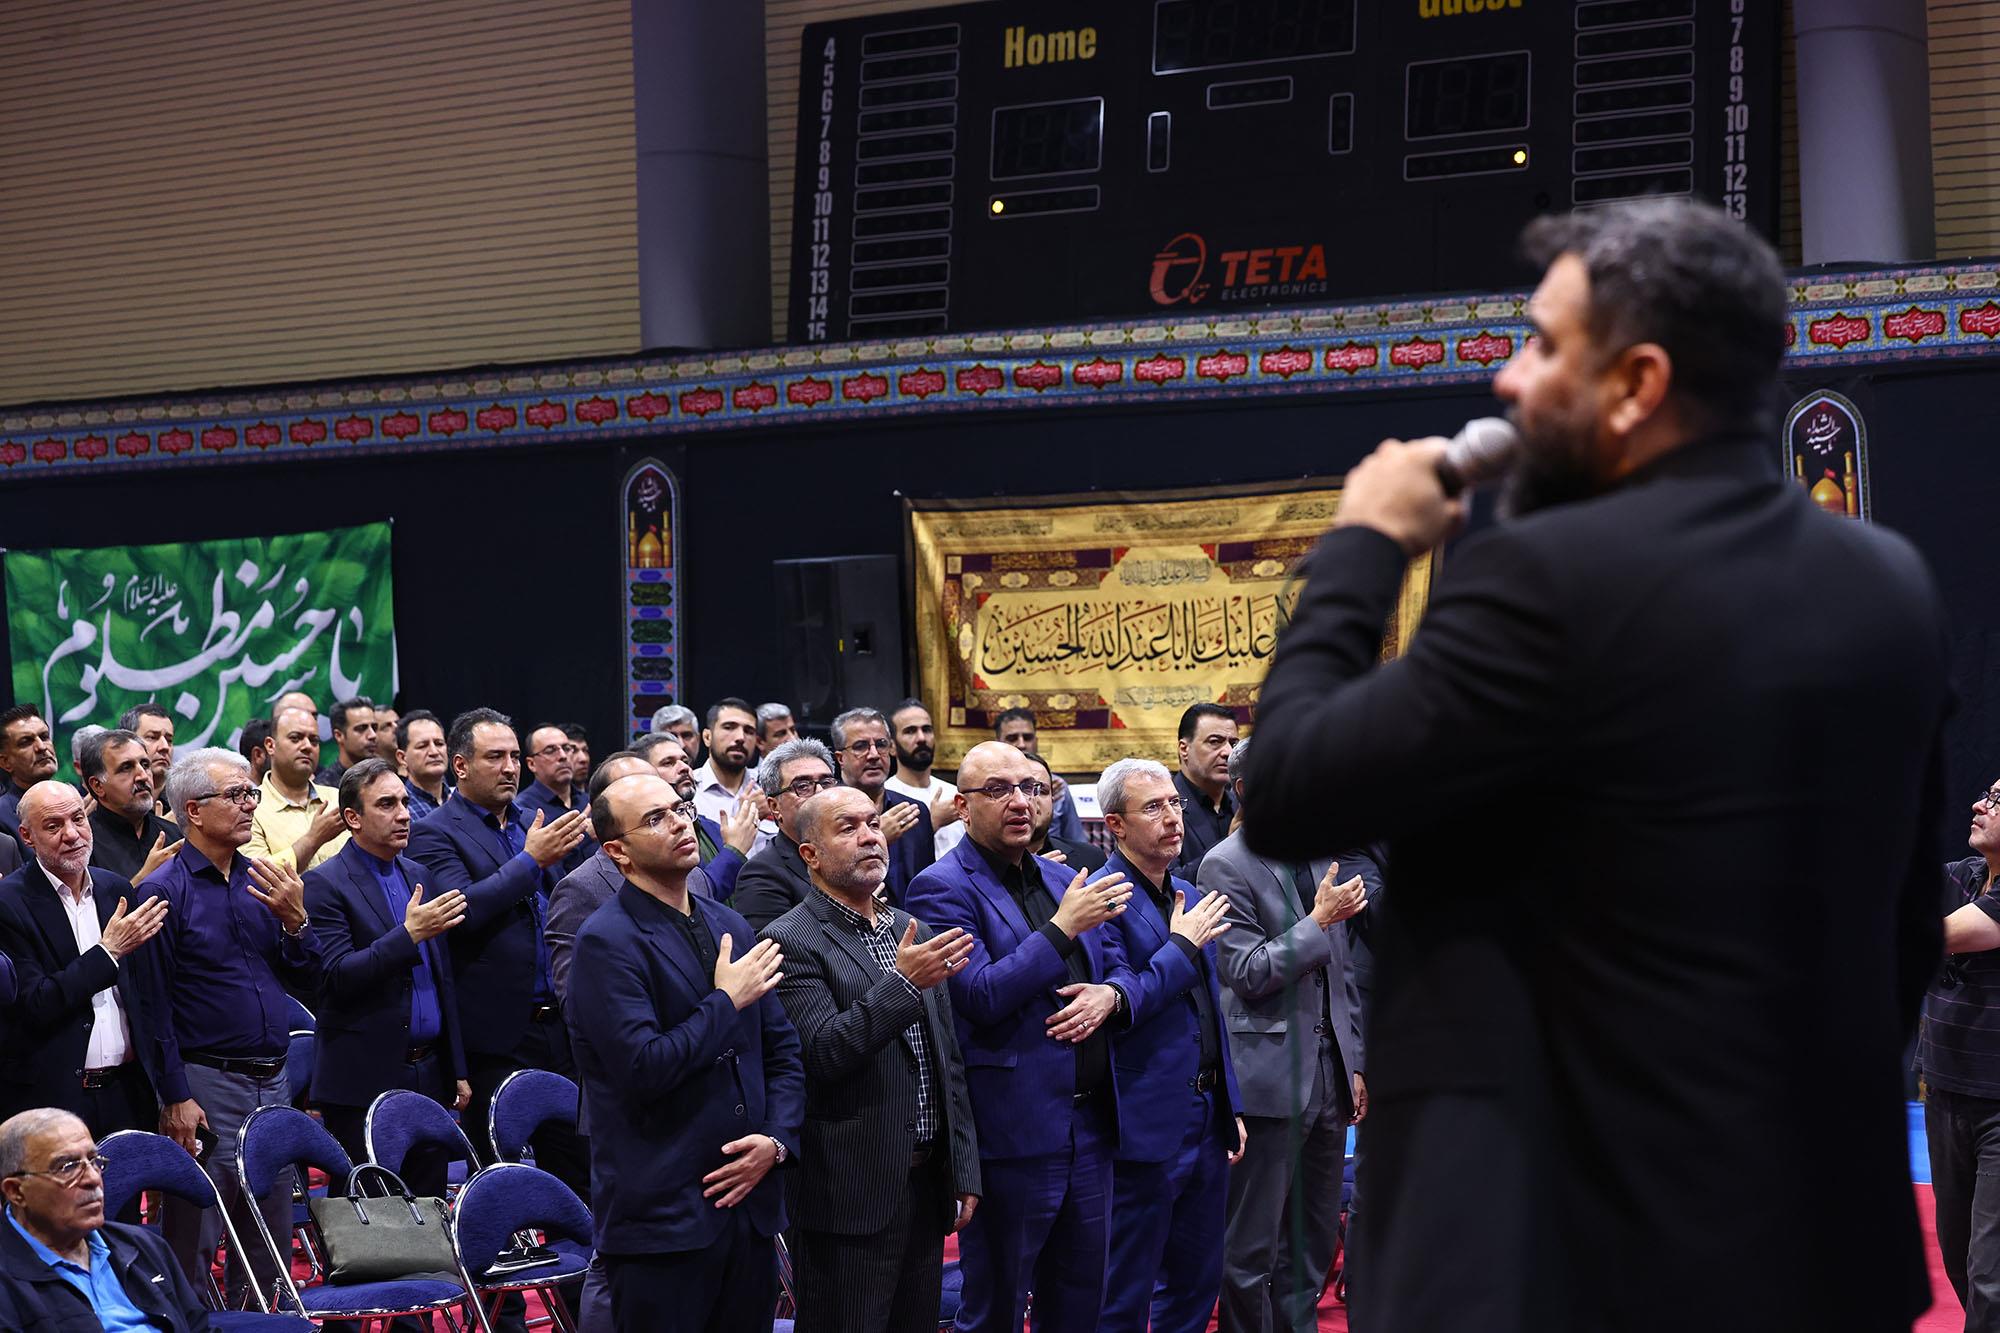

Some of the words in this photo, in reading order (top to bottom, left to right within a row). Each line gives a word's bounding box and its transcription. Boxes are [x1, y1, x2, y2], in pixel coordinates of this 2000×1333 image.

[1731, 16, 1744, 43] 7
[823, 37, 836, 61] 4
[1005, 27, 1096, 68] Home
[1730, 46, 1744, 73] 8
[823, 63, 834, 87] 5
[821, 88, 833, 112] 6
[1729, 75, 1743, 102] 9
[821, 114, 831, 139] 7
[1724, 104, 1749, 132] 10
[819, 140, 831, 164] 8
[1724, 134, 1745, 162] 11
[818, 165, 830, 190] 9
[1723, 163, 1748, 192] 12
[814, 191, 832, 216] 10
[1722, 193, 1746, 220] 13
[812, 217, 829, 242] 11
[811, 243, 830, 268] 12
[1220, 244, 1328, 287] TETA
[810, 269, 829, 294] 13
[1221, 281, 1328, 301] ELECTRONICS
[808, 295, 828, 320] 14
[807, 321, 827, 341] 15
[44, 559, 276, 738] مظلوم
